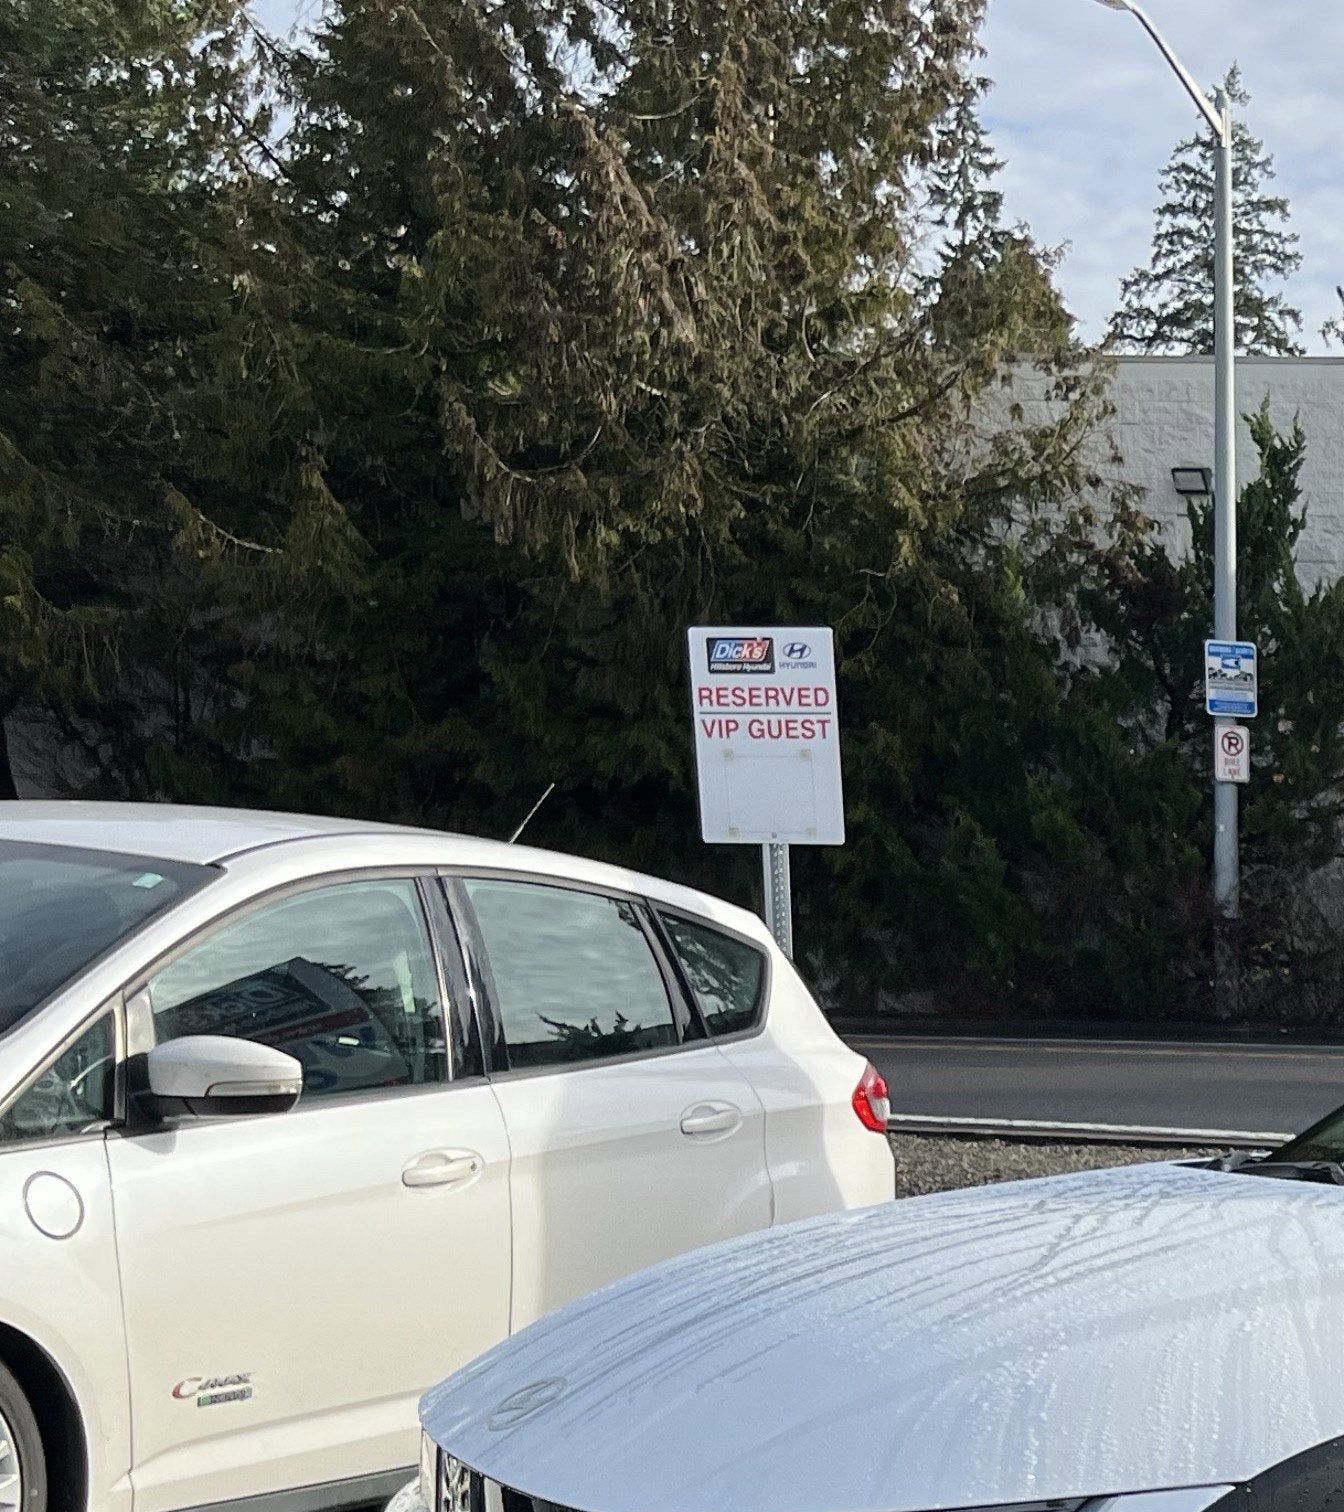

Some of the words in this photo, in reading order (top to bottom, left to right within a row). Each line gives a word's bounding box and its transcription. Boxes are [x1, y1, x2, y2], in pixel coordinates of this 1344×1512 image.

[778, 661, 817, 670] HYUNDAI
[698, 686, 830, 707] RESERVED
[701, 719, 739, 739] VIP
[748, 719, 831, 739] GUEST
